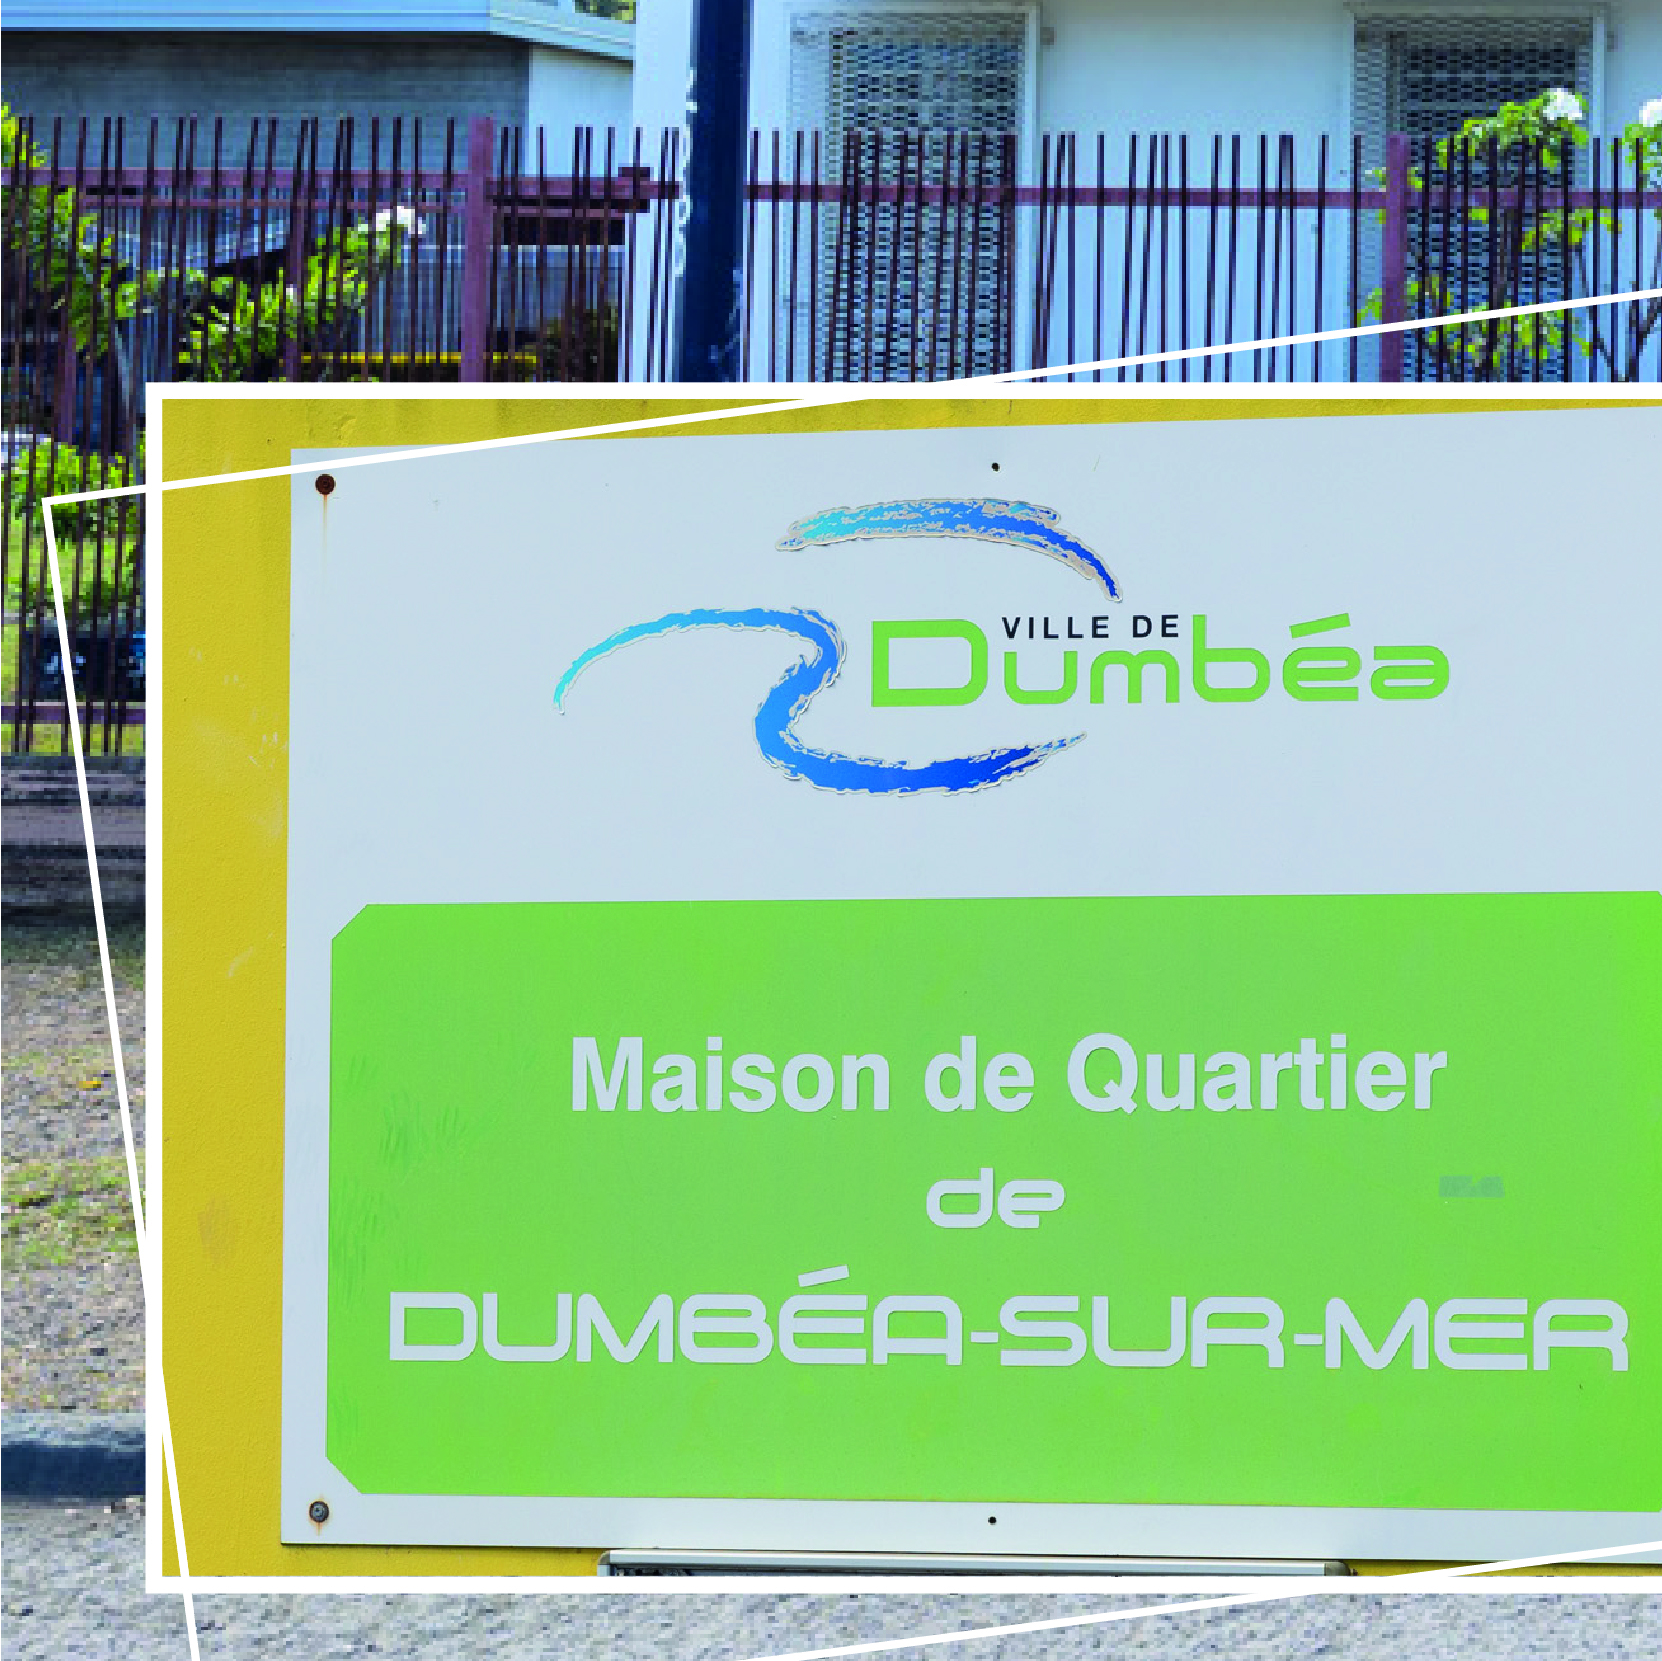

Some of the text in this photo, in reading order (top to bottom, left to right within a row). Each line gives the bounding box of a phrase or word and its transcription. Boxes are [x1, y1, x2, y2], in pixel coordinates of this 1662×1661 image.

[871, 613, 1450, 707] Dumbéa
[1001, 615, 1180, 639] VILLE DE
[572, 1033, 1448, 1114] Maison de Quartier
[926, 1167, 1066, 1229] de
[389, 1265, 1629, 1373] DUMBÉA-SUR-MER
